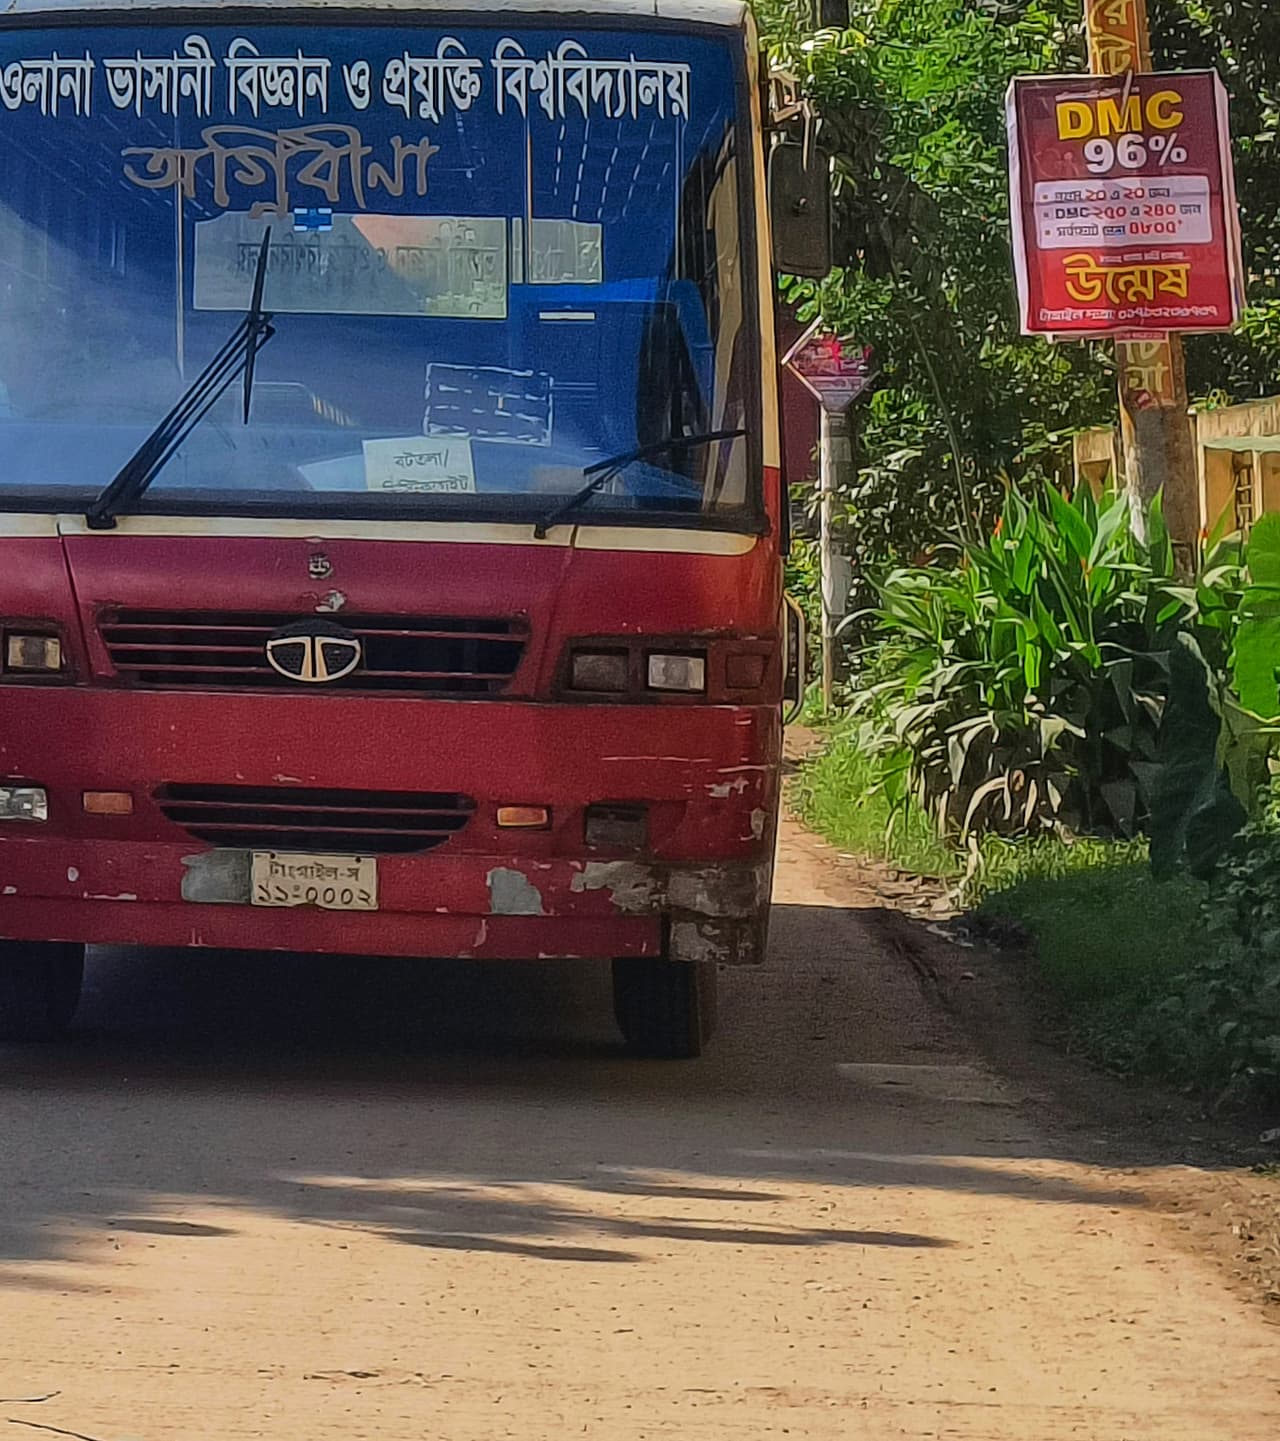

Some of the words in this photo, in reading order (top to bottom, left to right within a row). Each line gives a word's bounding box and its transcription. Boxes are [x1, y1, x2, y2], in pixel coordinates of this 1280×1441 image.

[103, 34, 216, 118] ভাসানী
[223, 38, 331, 118] বিজ্ঞান
[343, 60, 370, 109] ও
[383, 36, 483, 124] প্রযুক্তি
[490, 38, 691, 121] বিশ্ববিদ্যালয়
[1056, 90, 1183, 140] DMC
[1084, 133, 1187, 173] 96%
[1062, 253, 1191, 304] উন্মেষ
